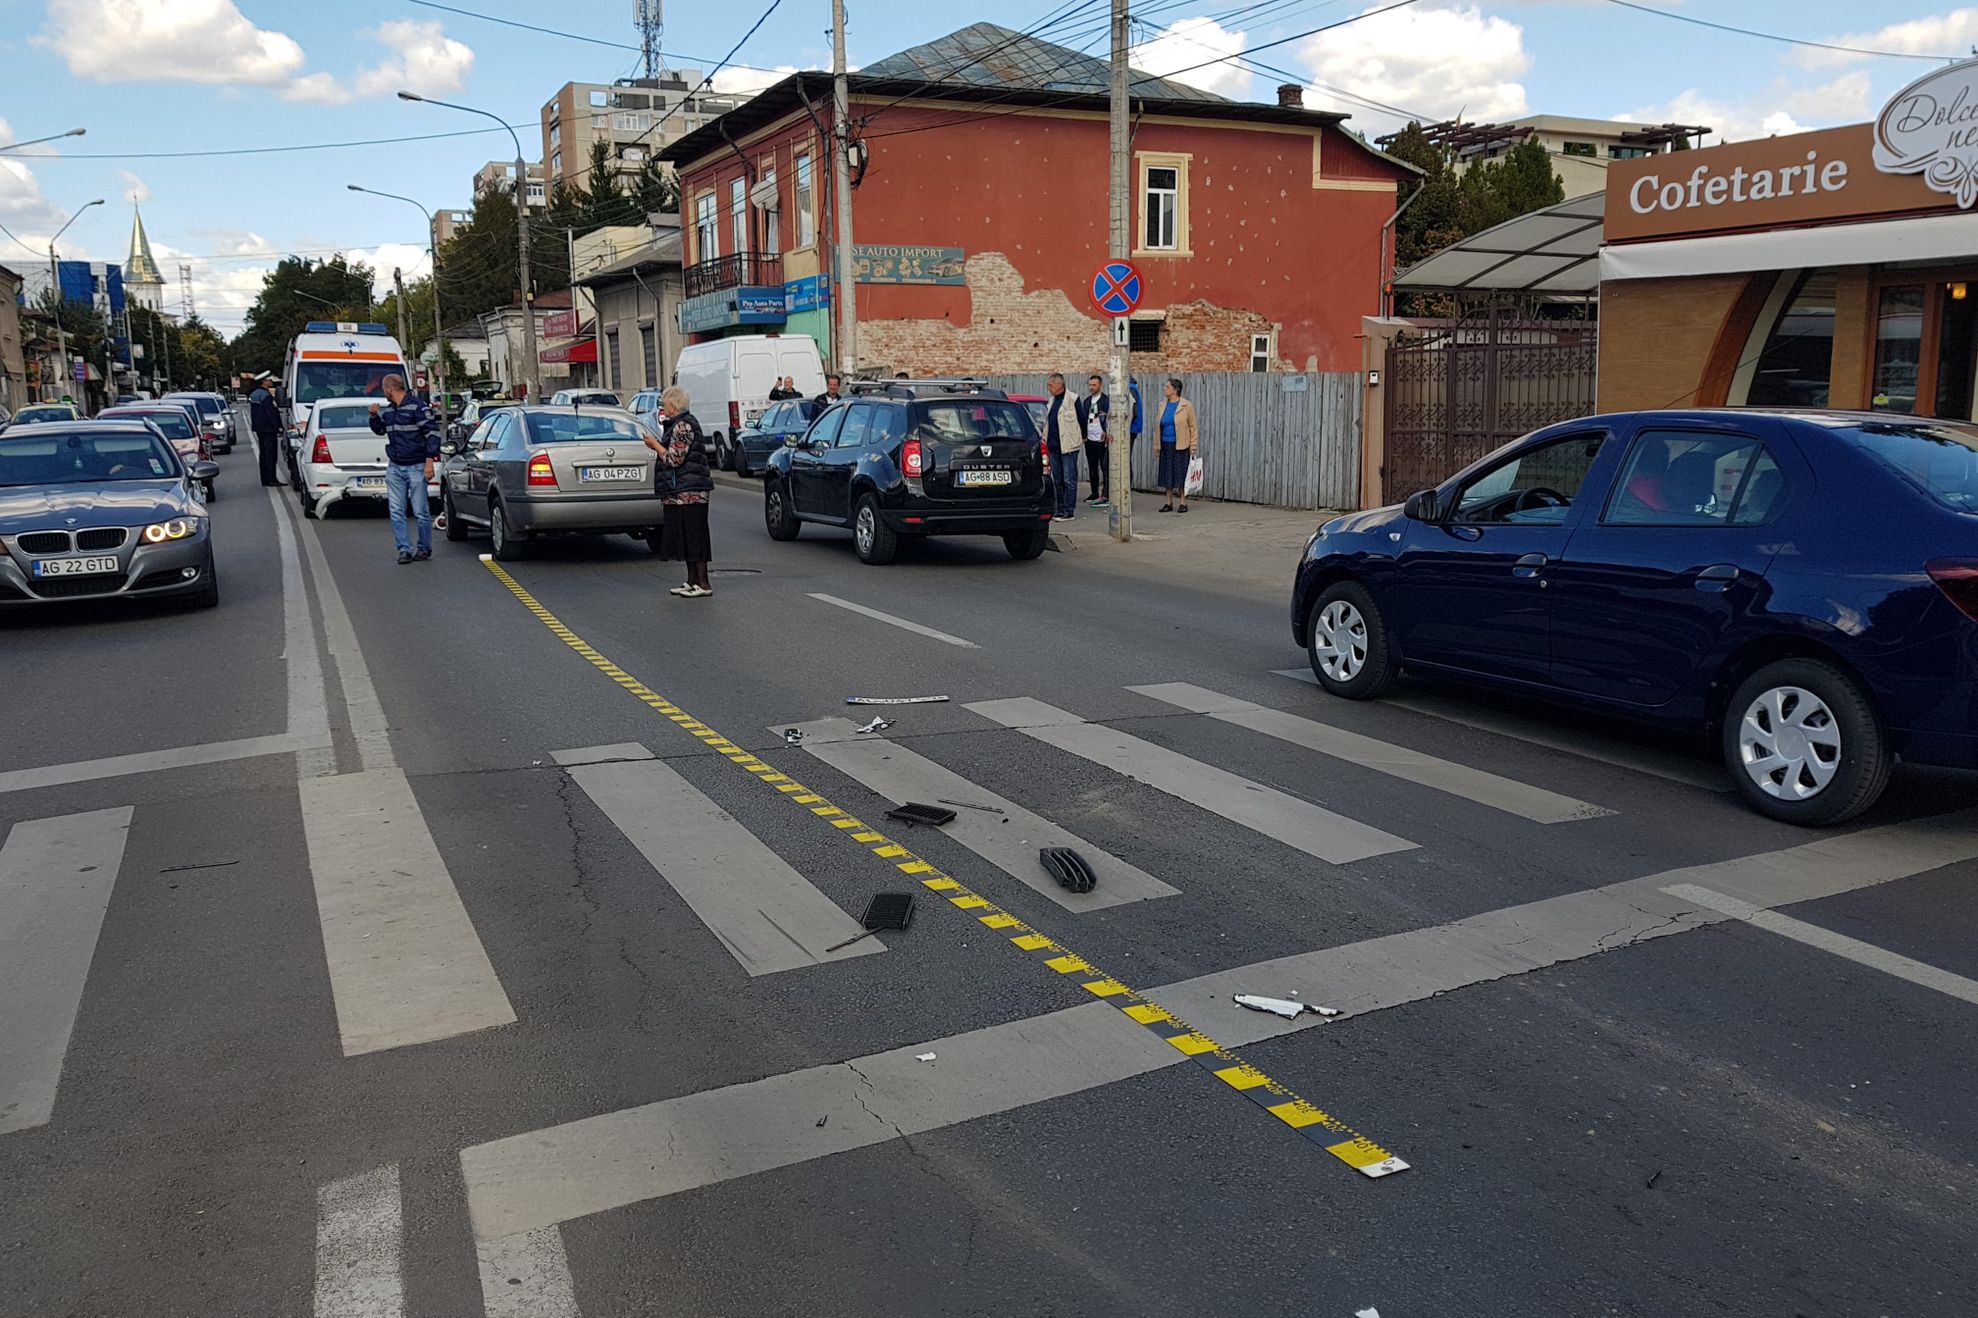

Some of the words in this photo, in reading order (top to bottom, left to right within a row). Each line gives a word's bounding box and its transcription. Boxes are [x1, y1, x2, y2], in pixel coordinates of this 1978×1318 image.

[1629, 150, 1848, 214] Cofetarie
[865, 247, 899, 257] AUTO
[901, 247, 945, 258] IMPORT
[589, 469, 601, 479] AG
[603, 469, 616, 479] 04
[616, 468, 638, 478] PZG
[965, 472, 977, 482] AG
[979, 472, 991, 481] 88
[992, 472, 1010, 481] ASD
[42, 561, 60, 575] AG
[65, 560, 83, 573] 22
[86, 557, 116, 571] GTD
[1325, 1123, 1345, 1133] 20
[1356, 1142, 1374, 1153] 10
